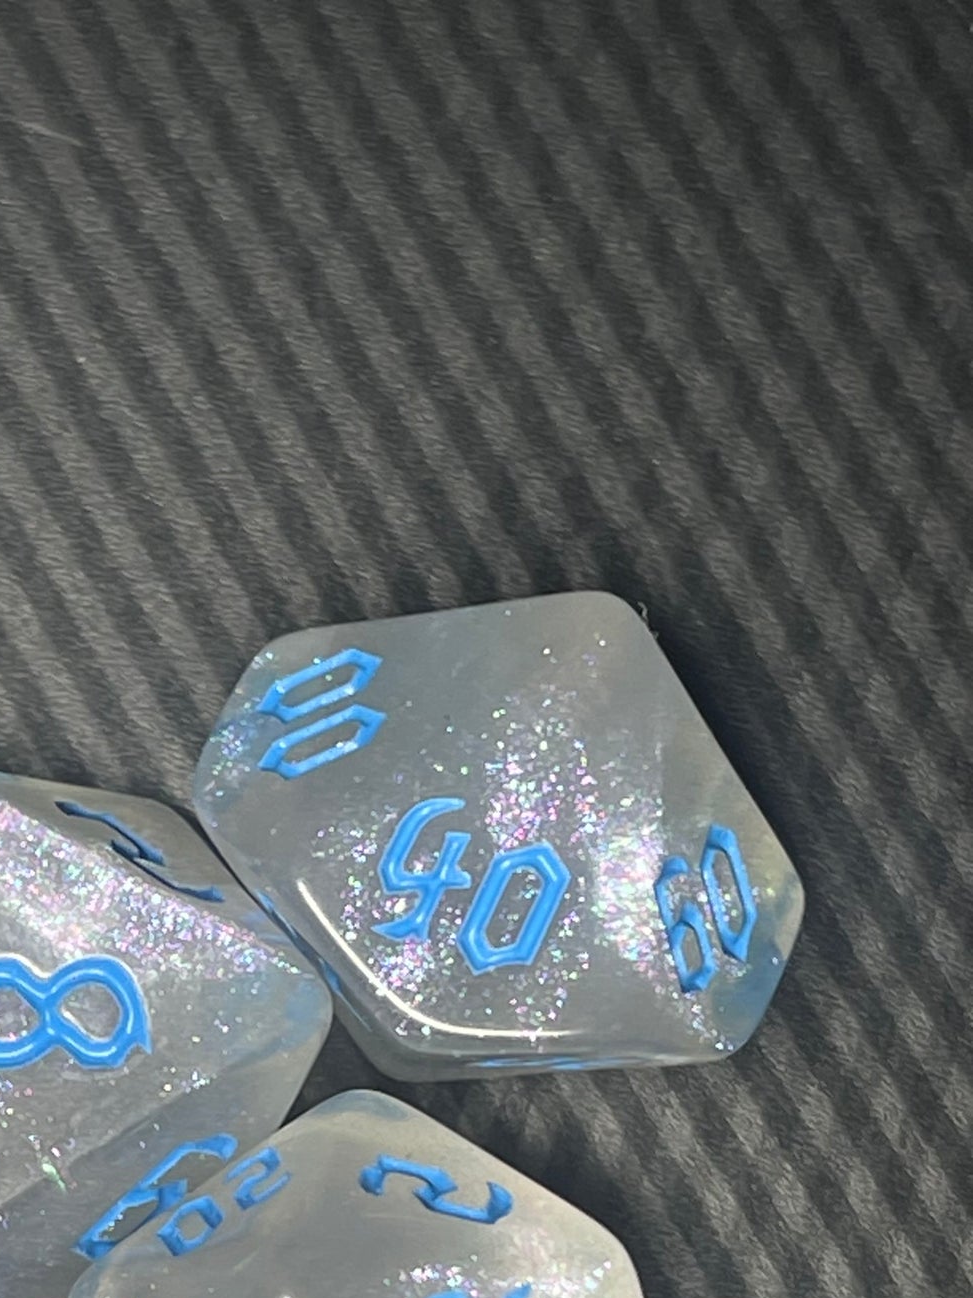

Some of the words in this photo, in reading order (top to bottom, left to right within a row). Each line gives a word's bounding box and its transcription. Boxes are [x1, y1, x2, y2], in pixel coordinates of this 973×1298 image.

[253, 648, 388, 781] 00
[371, 797, 573, 976] 40
[653, 823, 759, 995] 60
[155, 1145, 294, 1257] 20
[357, 1153, 515, 1226] 2
